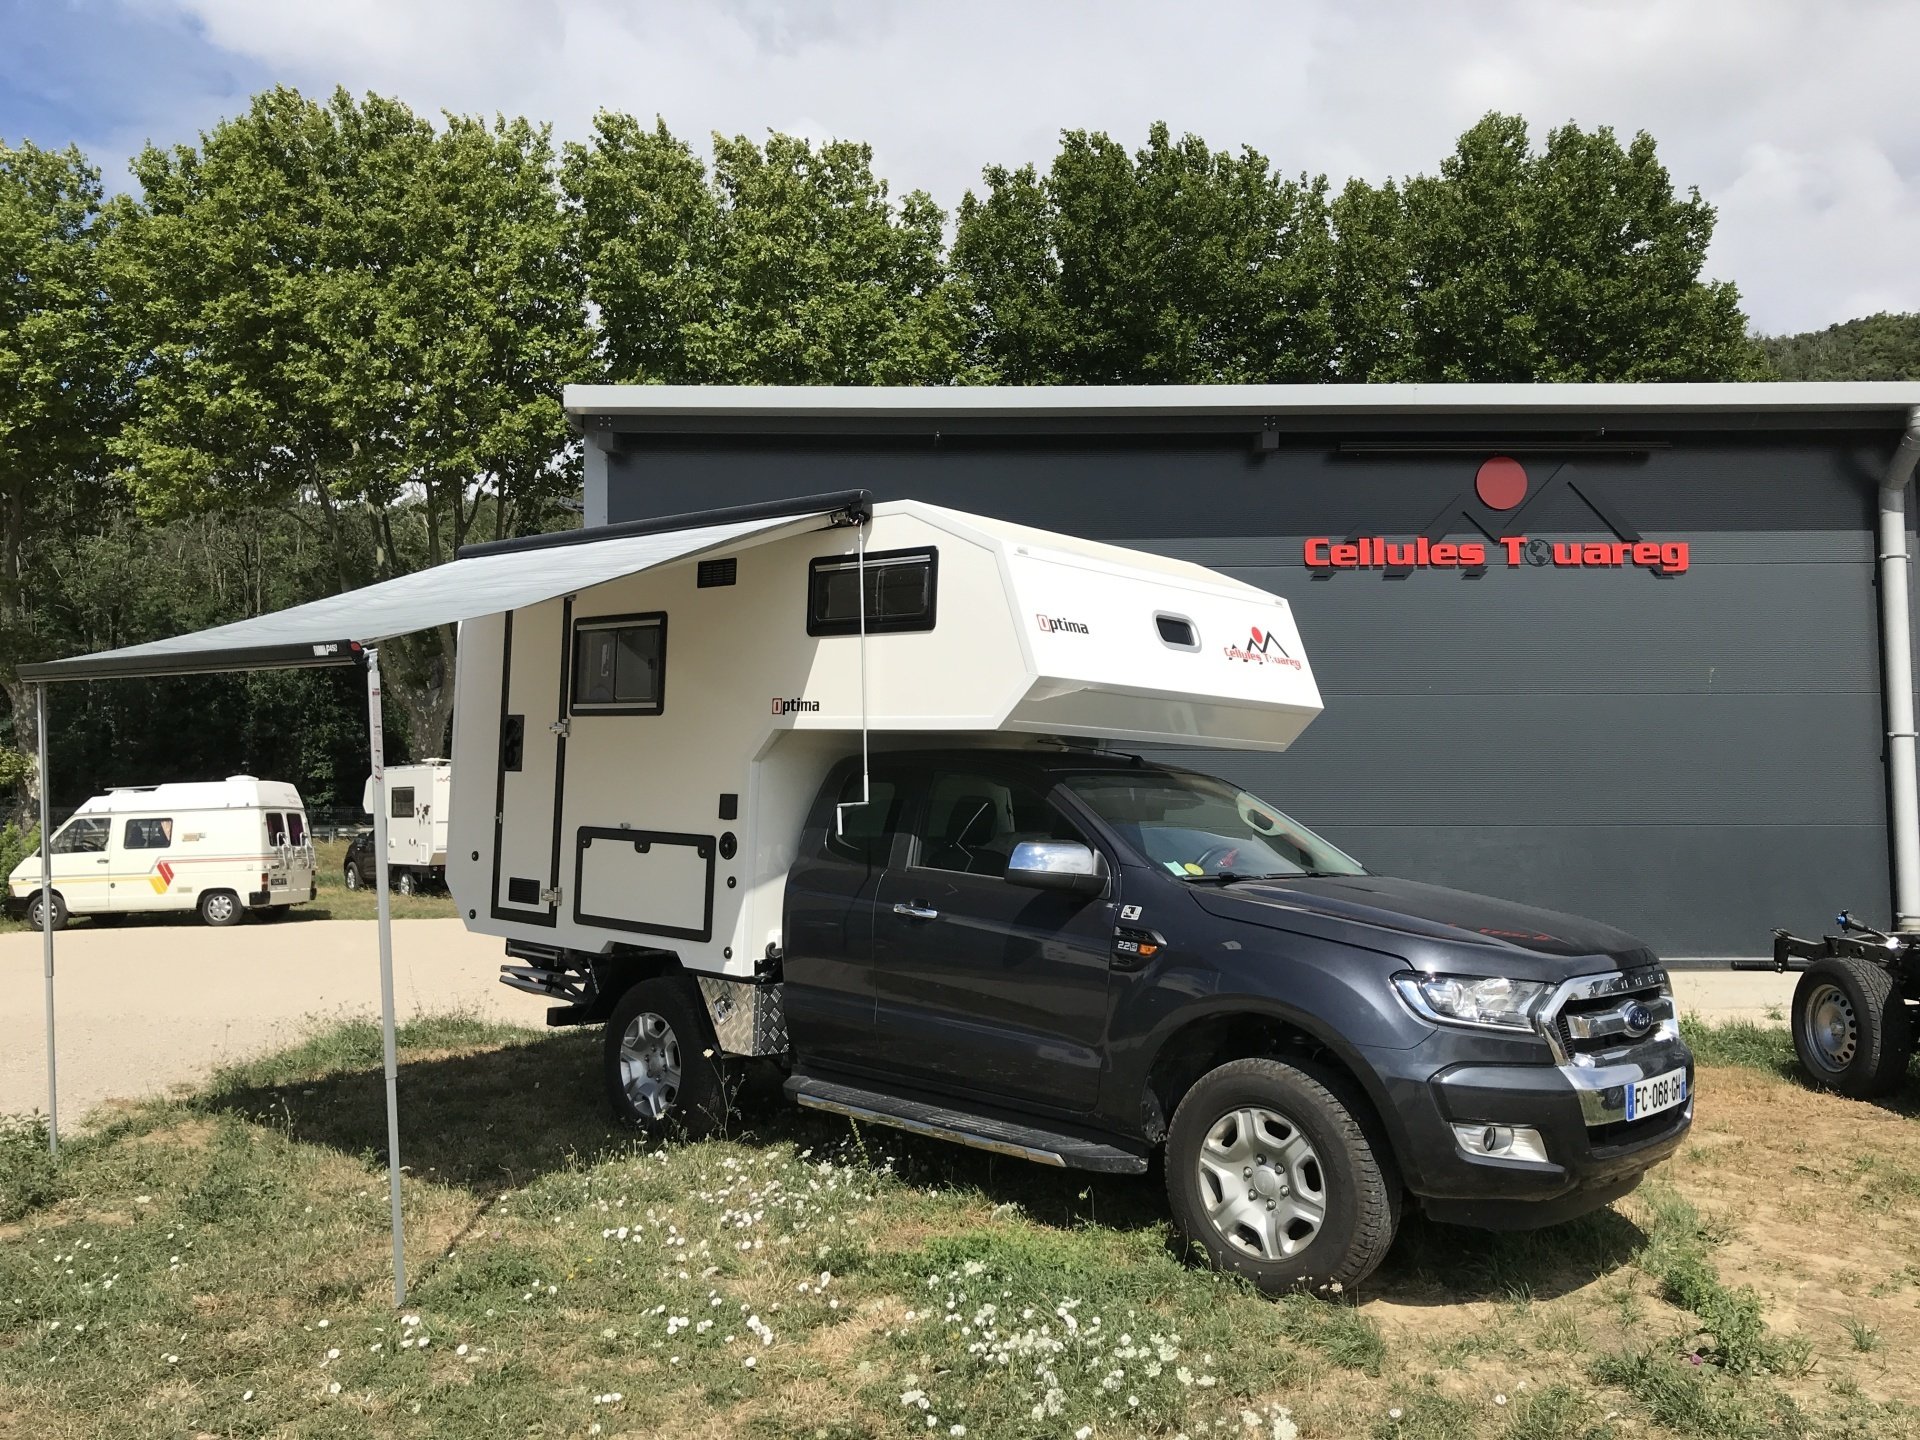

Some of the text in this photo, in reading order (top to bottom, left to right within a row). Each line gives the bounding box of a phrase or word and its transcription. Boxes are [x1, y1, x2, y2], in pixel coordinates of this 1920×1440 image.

[1304, 536, 1486, 567] Cellules
[1036, 614, 1089, 634] Optima
[1223, 647, 1263, 662] Cellules
[771, 697, 820, 715] Optima
